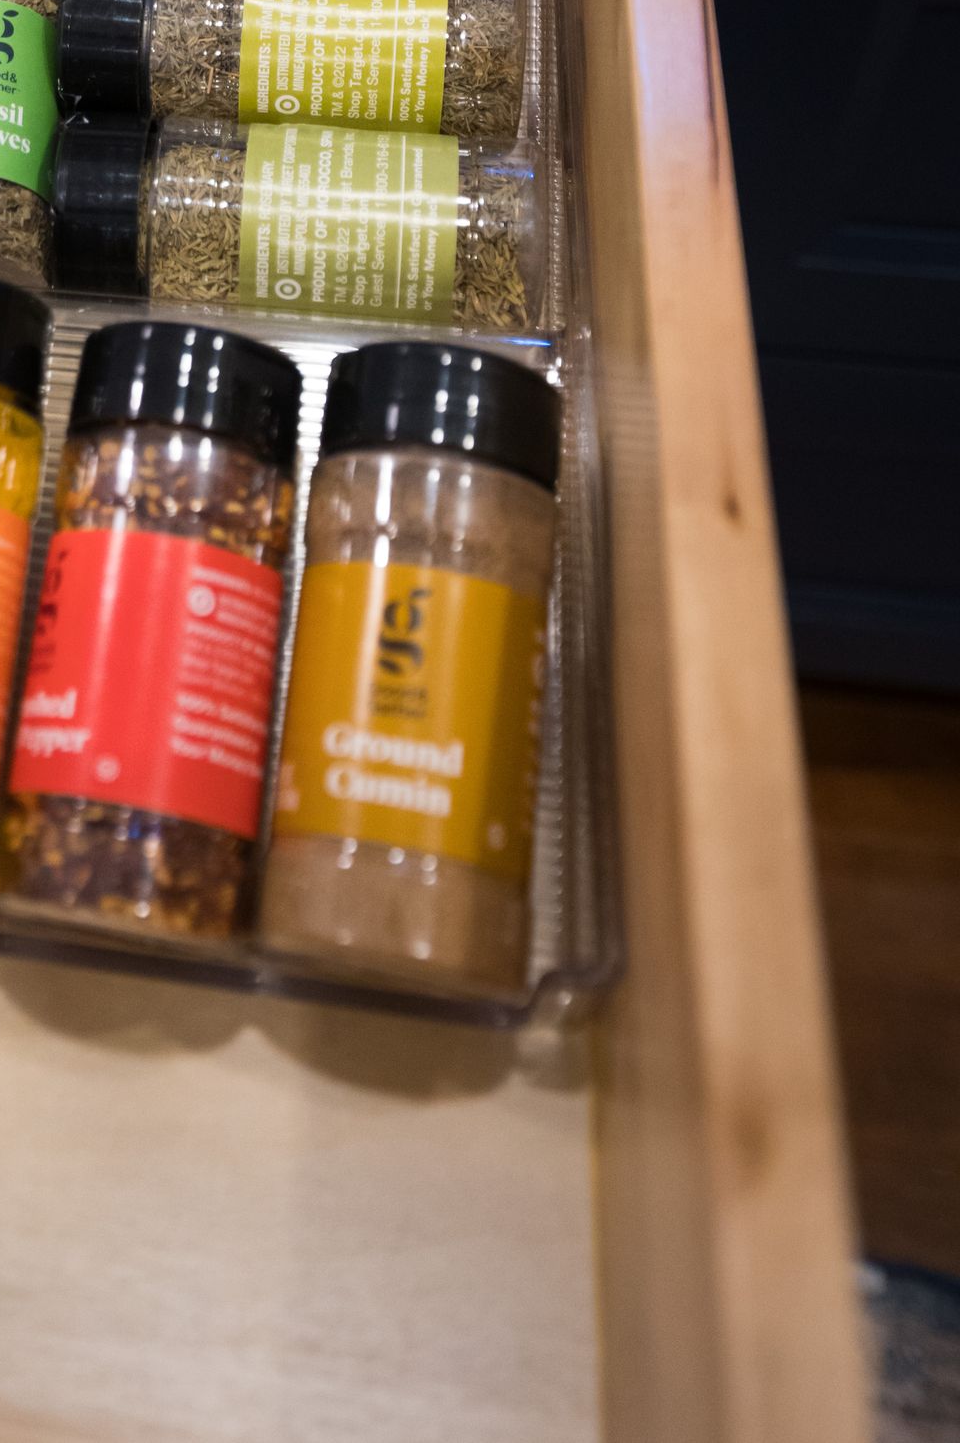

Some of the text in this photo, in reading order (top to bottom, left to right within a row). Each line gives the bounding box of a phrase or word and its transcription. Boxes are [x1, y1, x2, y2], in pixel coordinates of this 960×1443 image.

[313, 39, 326, 57] OF
[416, 47, 432, 86] Money
[311, 60, 325, 116] PRODUCT
[415, 89, 427, 112] Your
[331, 102, 343, 116] TM
[348, 91, 363, 118] Shop
[365, 89, 378, 119] Guest
[400, 97, 411, 121] 100%
[315, 219, 328, 239] OF
[424, 228, 439, 272] Money
[312, 242, 326, 302] PRODUCT
[422, 274, 435, 298] Your
[334, 286, 347, 304] TM
[352, 275, 368, 305] Shop
[370, 273, 384, 307] Guest
[407, 283, 419, 310] 100%
[322, 721, 465, 779] Ground
[324, 760, 453, 819] Cumin
